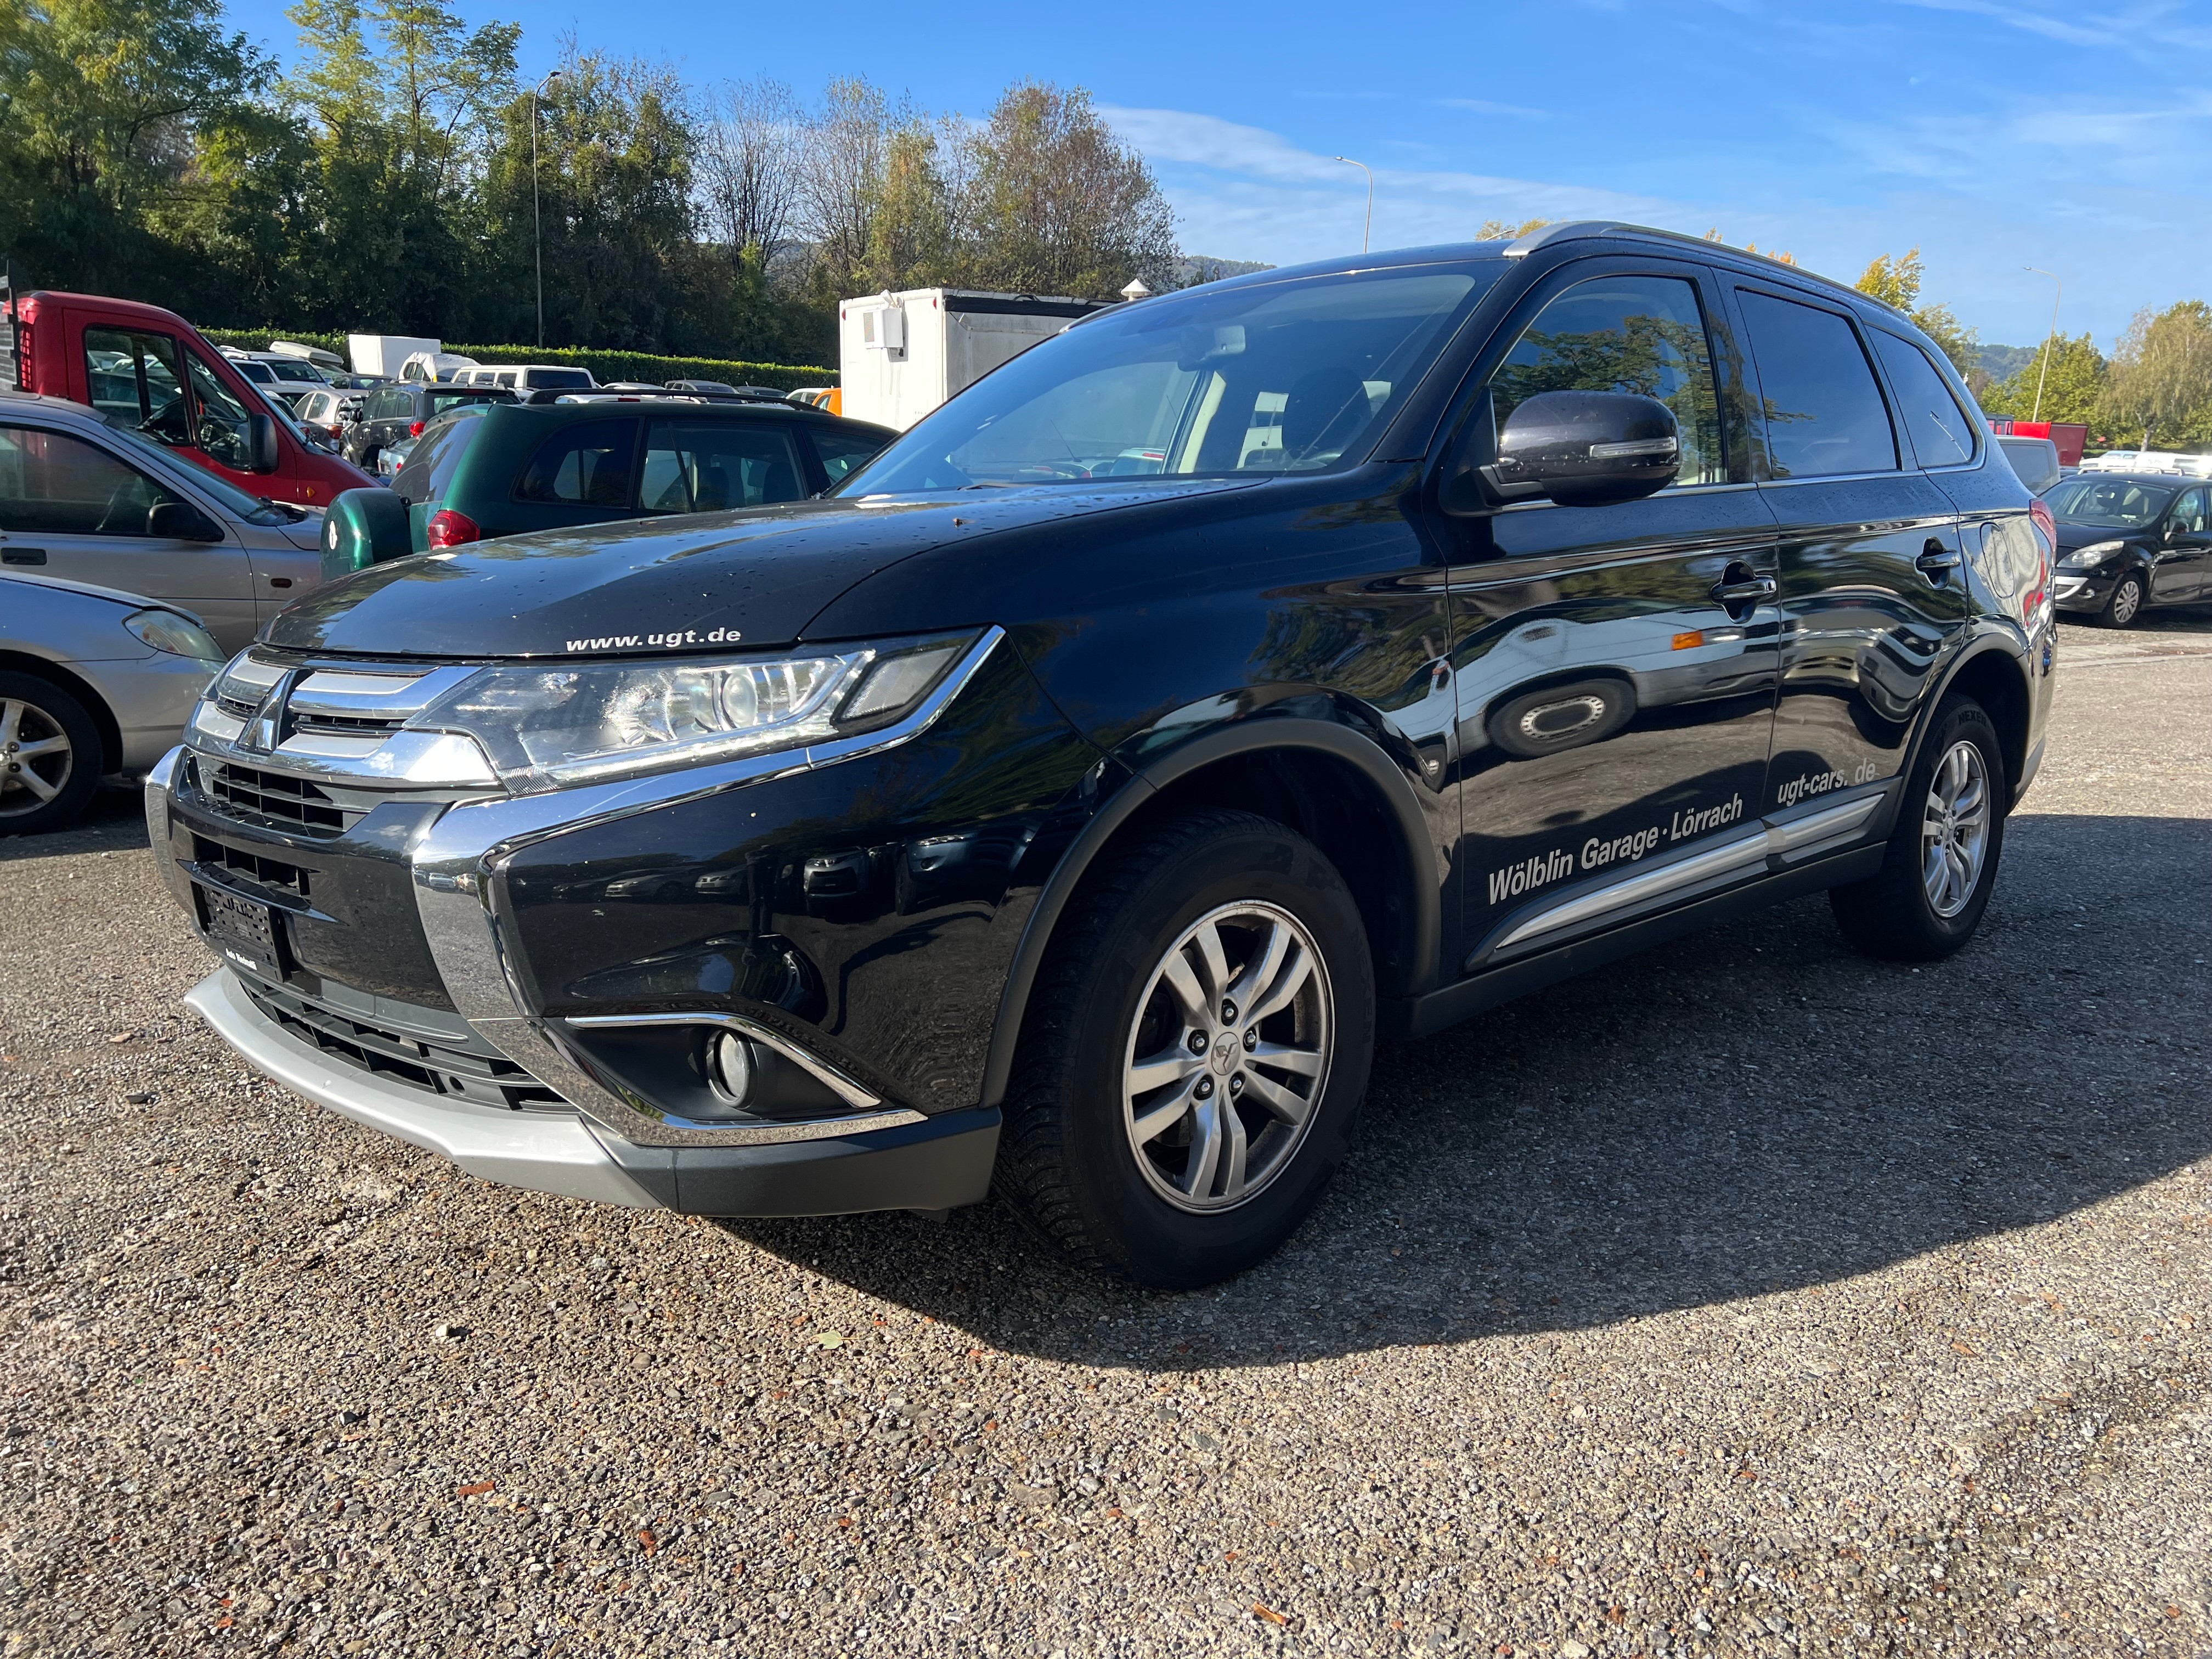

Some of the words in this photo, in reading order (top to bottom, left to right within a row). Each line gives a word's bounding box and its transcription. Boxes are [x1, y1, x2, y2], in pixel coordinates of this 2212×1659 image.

[566, 627, 741, 652] www.ugt.de
[1957, 710, 1987, 727] NEXEN
[1489, 848, 1573, 905] Wölblin
[1581, 826, 1659, 870] Garage
[1670, 792, 1743, 841] Lörrach
[1351, 926, 1373, 1044] NEXEN
